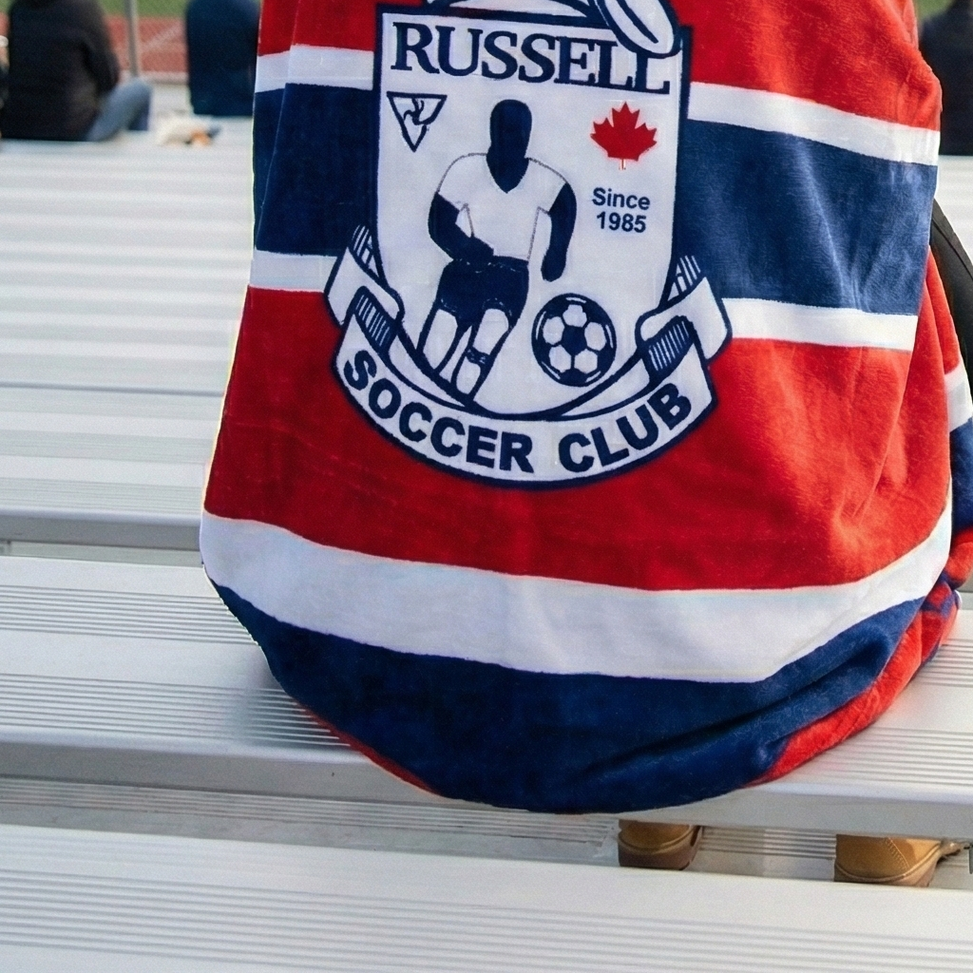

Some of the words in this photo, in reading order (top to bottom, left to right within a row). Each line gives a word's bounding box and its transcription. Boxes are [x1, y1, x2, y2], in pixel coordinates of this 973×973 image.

[390, 21, 671, 95] RUSSELL
[592, 187, 651, 211] Since
[596, 211, 647, 233] 1985
[343, 349, 535, 474] SOCCER
[558, 383, 692, 473] CLUB
